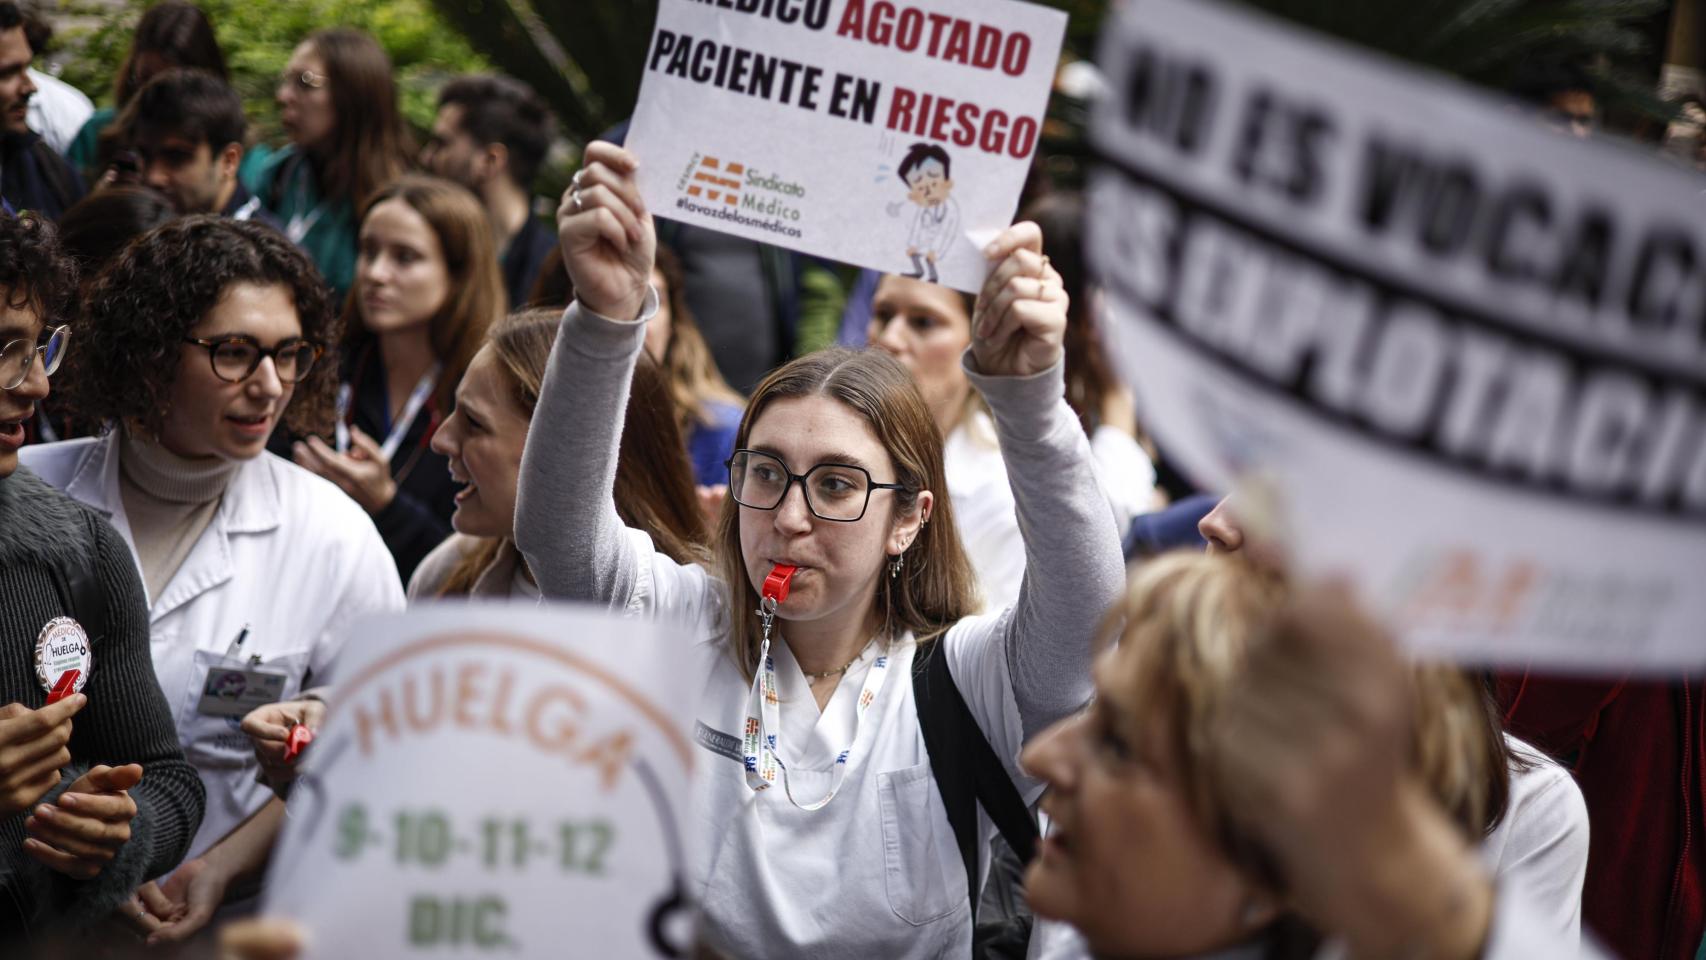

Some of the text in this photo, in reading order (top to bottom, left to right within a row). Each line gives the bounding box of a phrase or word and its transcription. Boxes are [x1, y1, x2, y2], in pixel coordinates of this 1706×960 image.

[836, 0, 1032, 77] AGOTADO
[649, 29, 1038, 159] PACIENTE EN RIESGO
[743, 193, 800, 221] Médico
[745, 168, 805, 198] Sindicato
[1126, 47, 1706, 342] NO ES VOCAC
[52, 642, 80, 657] HUELGA
[352, 662, 637, 793] HUELGA
[407, 892, 521, 953] DIC.
